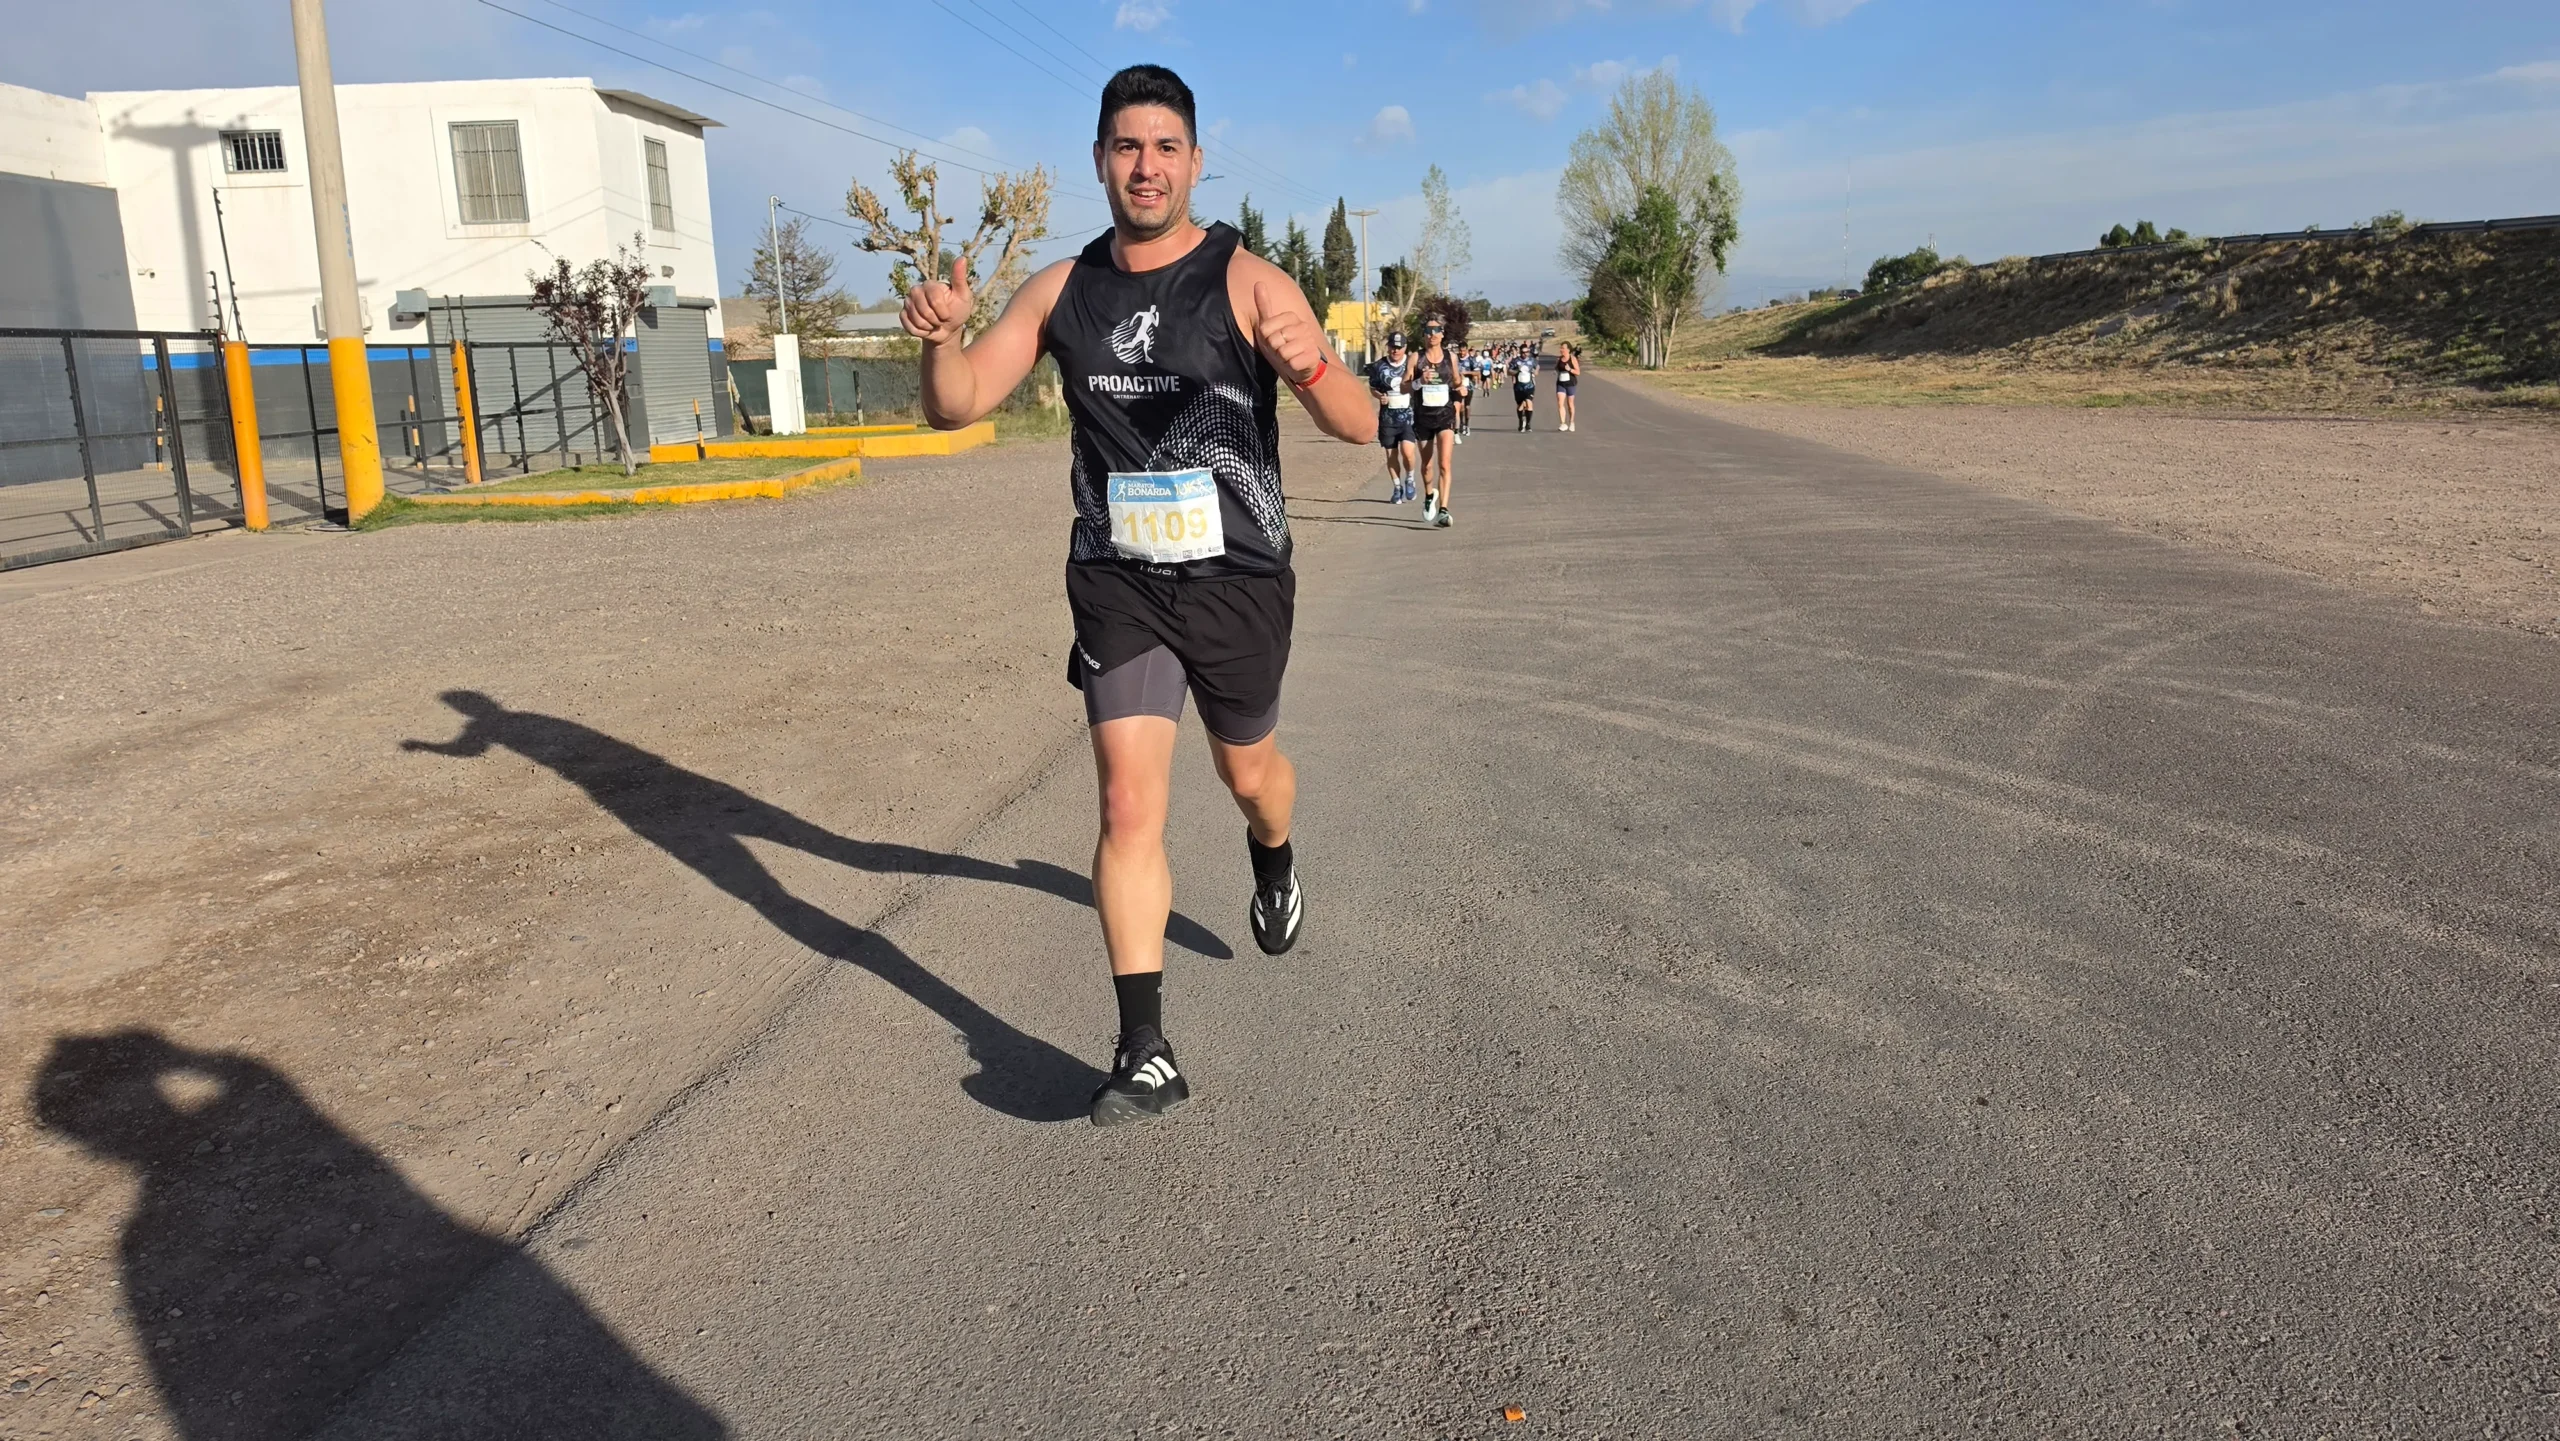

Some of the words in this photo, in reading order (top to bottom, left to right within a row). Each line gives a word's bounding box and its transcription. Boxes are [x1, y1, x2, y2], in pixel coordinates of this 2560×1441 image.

[1088, 375, 1180, 392] PROACTIVE
[1128, 488, 1171, 496] BONARDA
[1122, 508, 1207, 542] 1109
